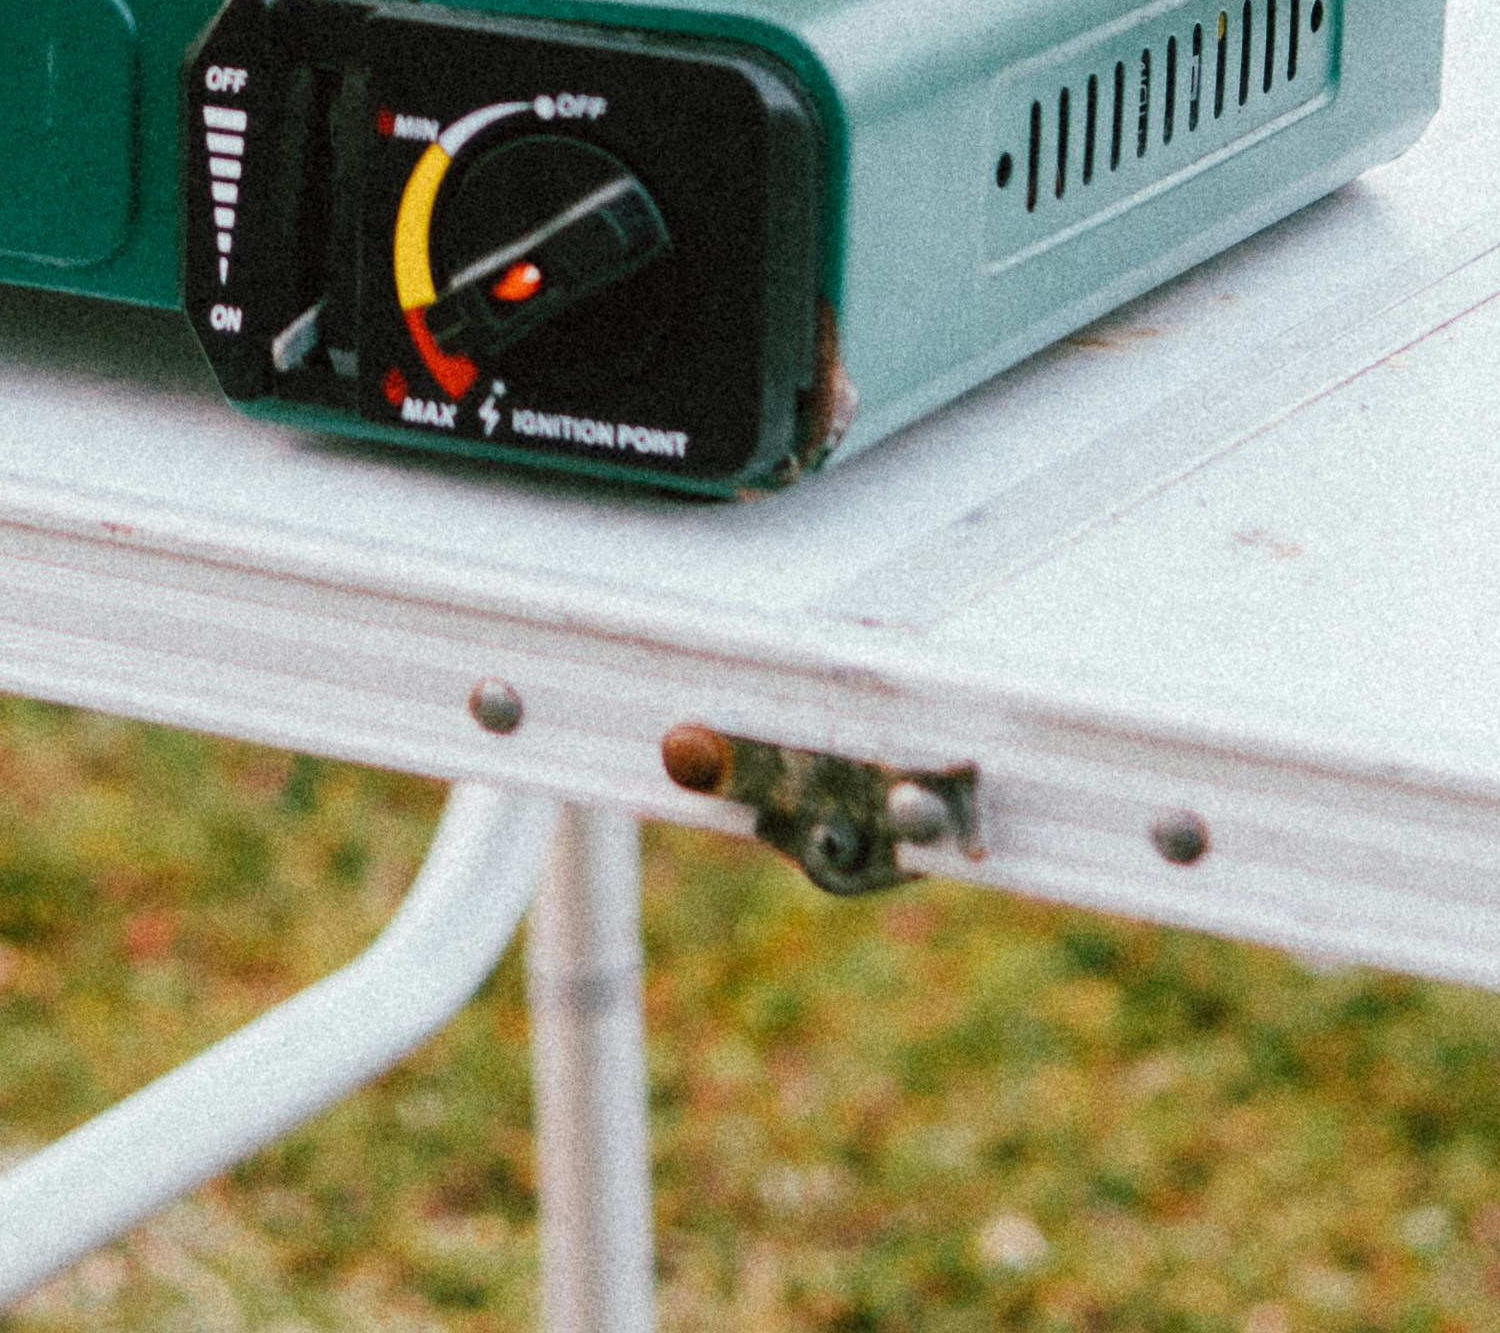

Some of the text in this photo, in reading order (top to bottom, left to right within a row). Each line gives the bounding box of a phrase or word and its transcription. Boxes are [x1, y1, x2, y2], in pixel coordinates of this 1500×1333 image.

[205, 65, 248, 94] OFF
[556, 92, 608, 121] OFF
[393, 113, 440, 142] MIN
[209, 304, 243, 333] ON
[401, 396, 458, 429] MAX
[511, 408, 688, 459] IGNITION POINT
